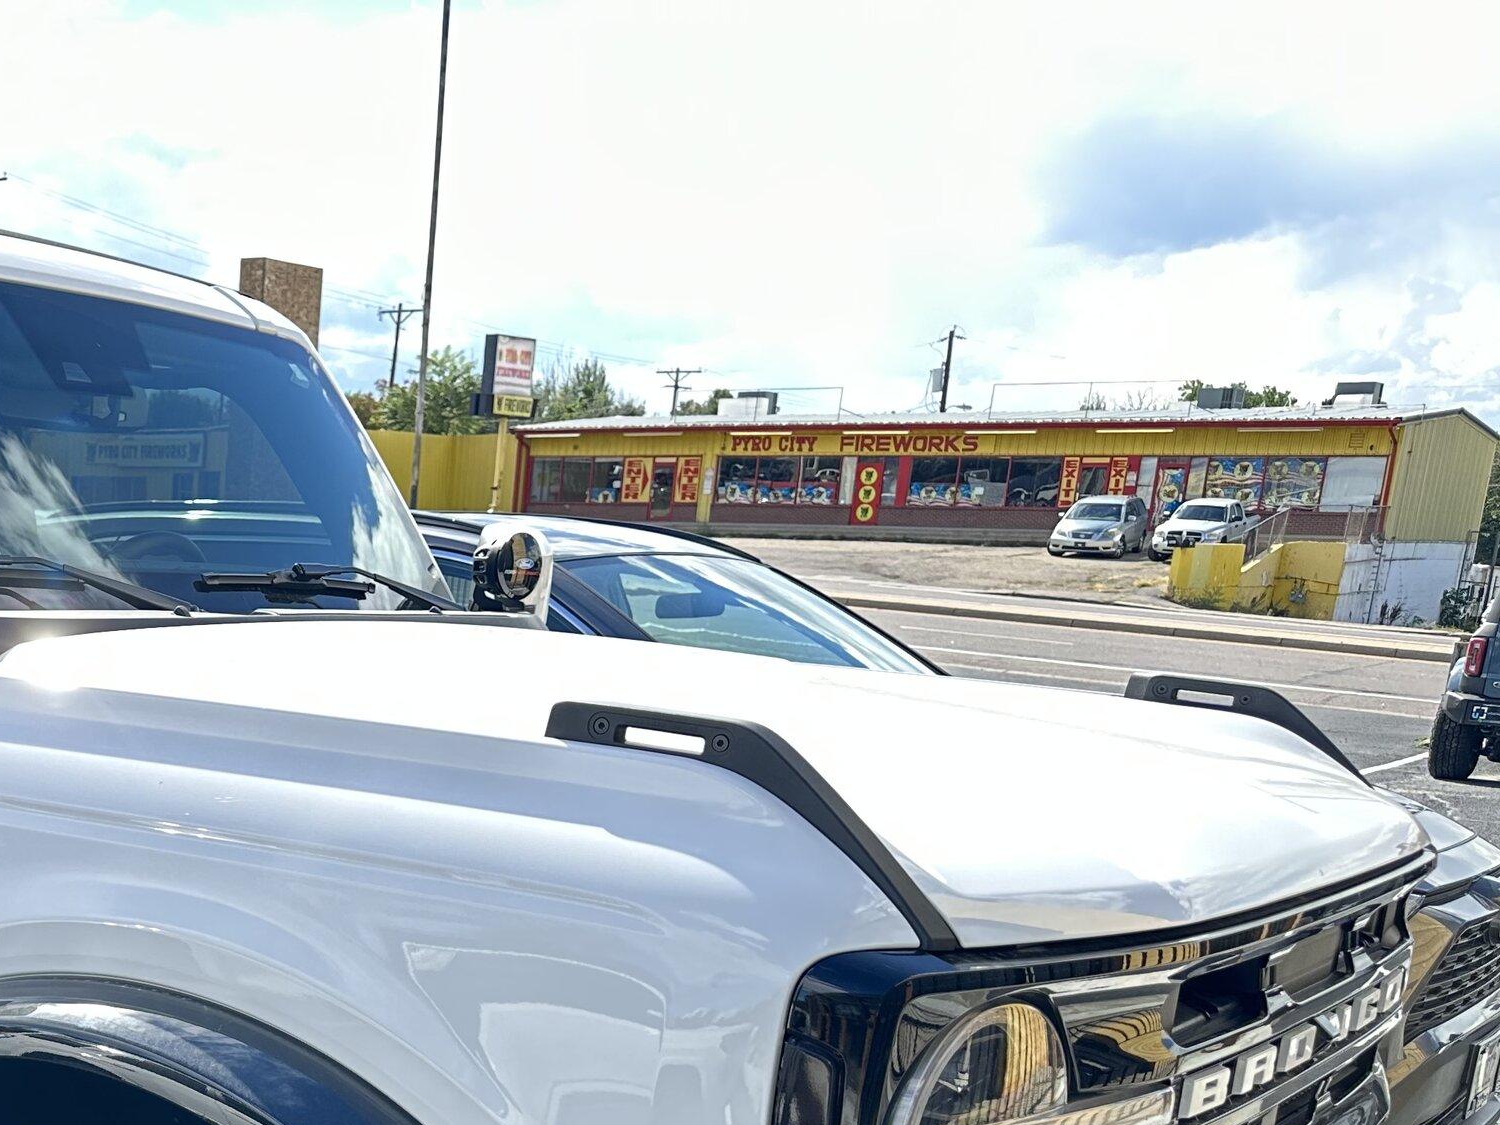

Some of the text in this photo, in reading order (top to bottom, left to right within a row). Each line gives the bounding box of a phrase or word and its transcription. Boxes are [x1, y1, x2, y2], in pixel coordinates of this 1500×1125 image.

[731, 435, 979, 453] PYRO CITY FIREWORKS
[624, 460, 643, 500] ENTER
[681, 460, 699, 501] ENTER
[1062, 460, 1079, 498] EXIT
[1109, 460, 1127, 495] EXIT
[1178, 967, 1405, 1119] BRONCO
